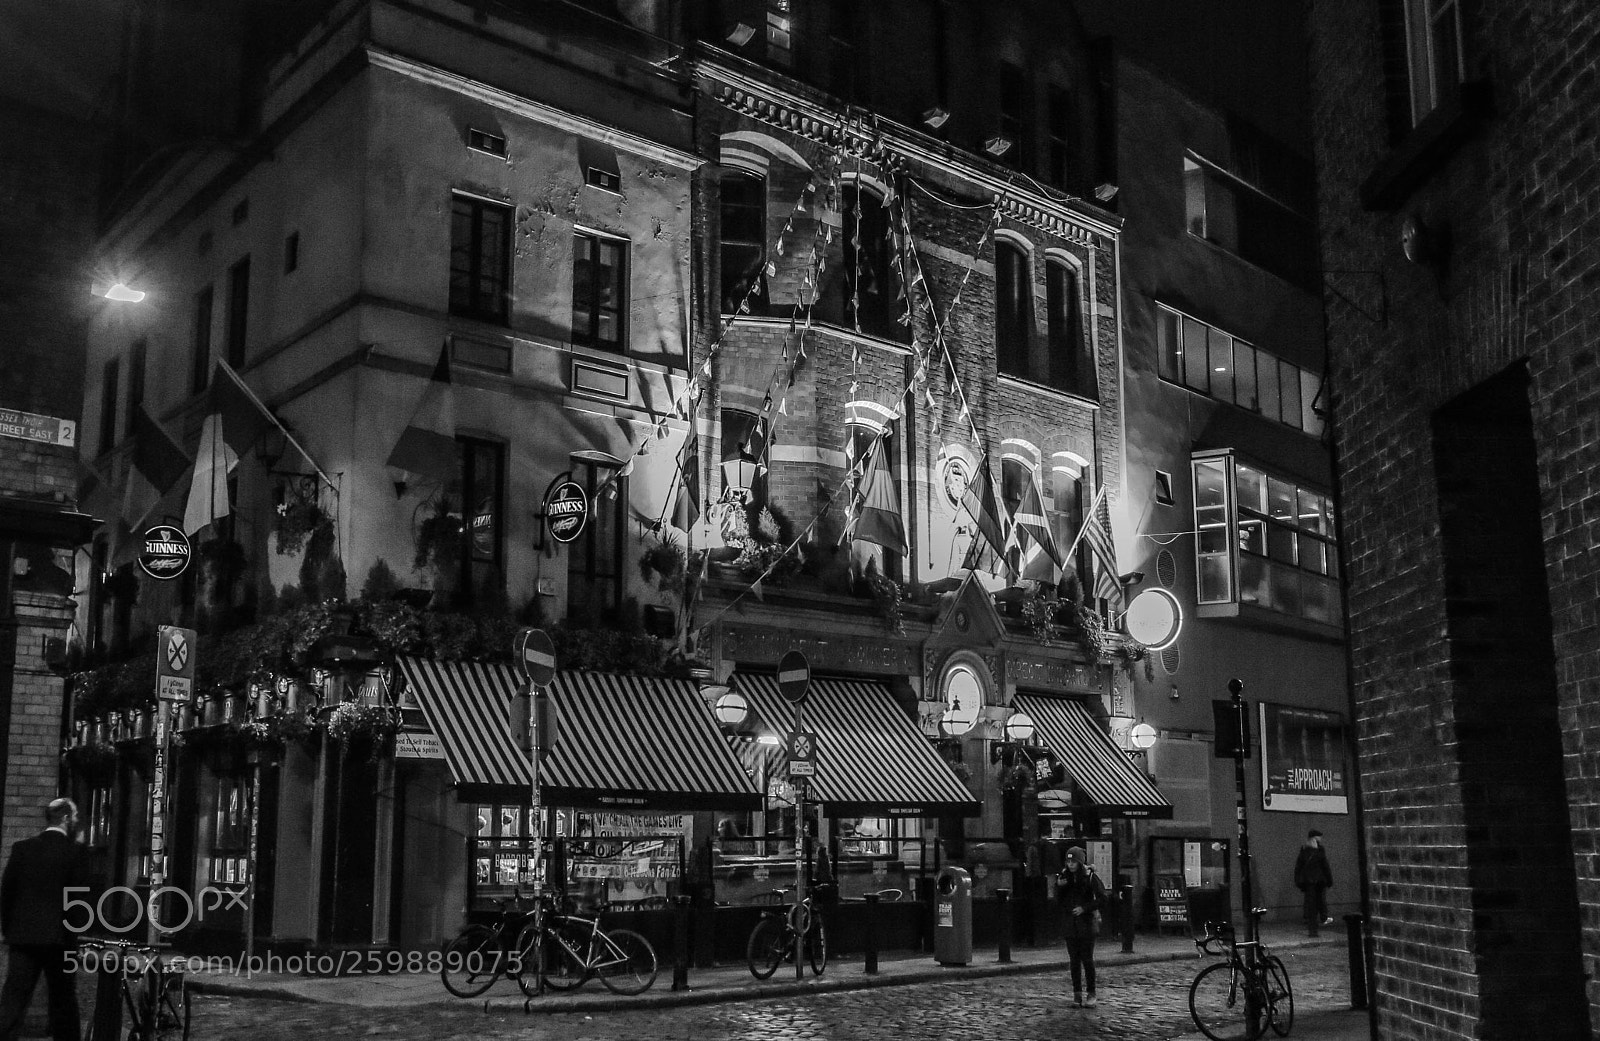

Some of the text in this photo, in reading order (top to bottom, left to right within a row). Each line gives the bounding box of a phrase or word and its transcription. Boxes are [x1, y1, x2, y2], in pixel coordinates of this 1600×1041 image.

[29, 428, 54, 440] EAST
[63, 426, 72, 440] 2
[1287, 769, 1295, 789] THE
[1294, 768, 1333, 791] APPROACH
[668, 815, 683, 828] LIVE
[656, 865, 670, 878] Fan
